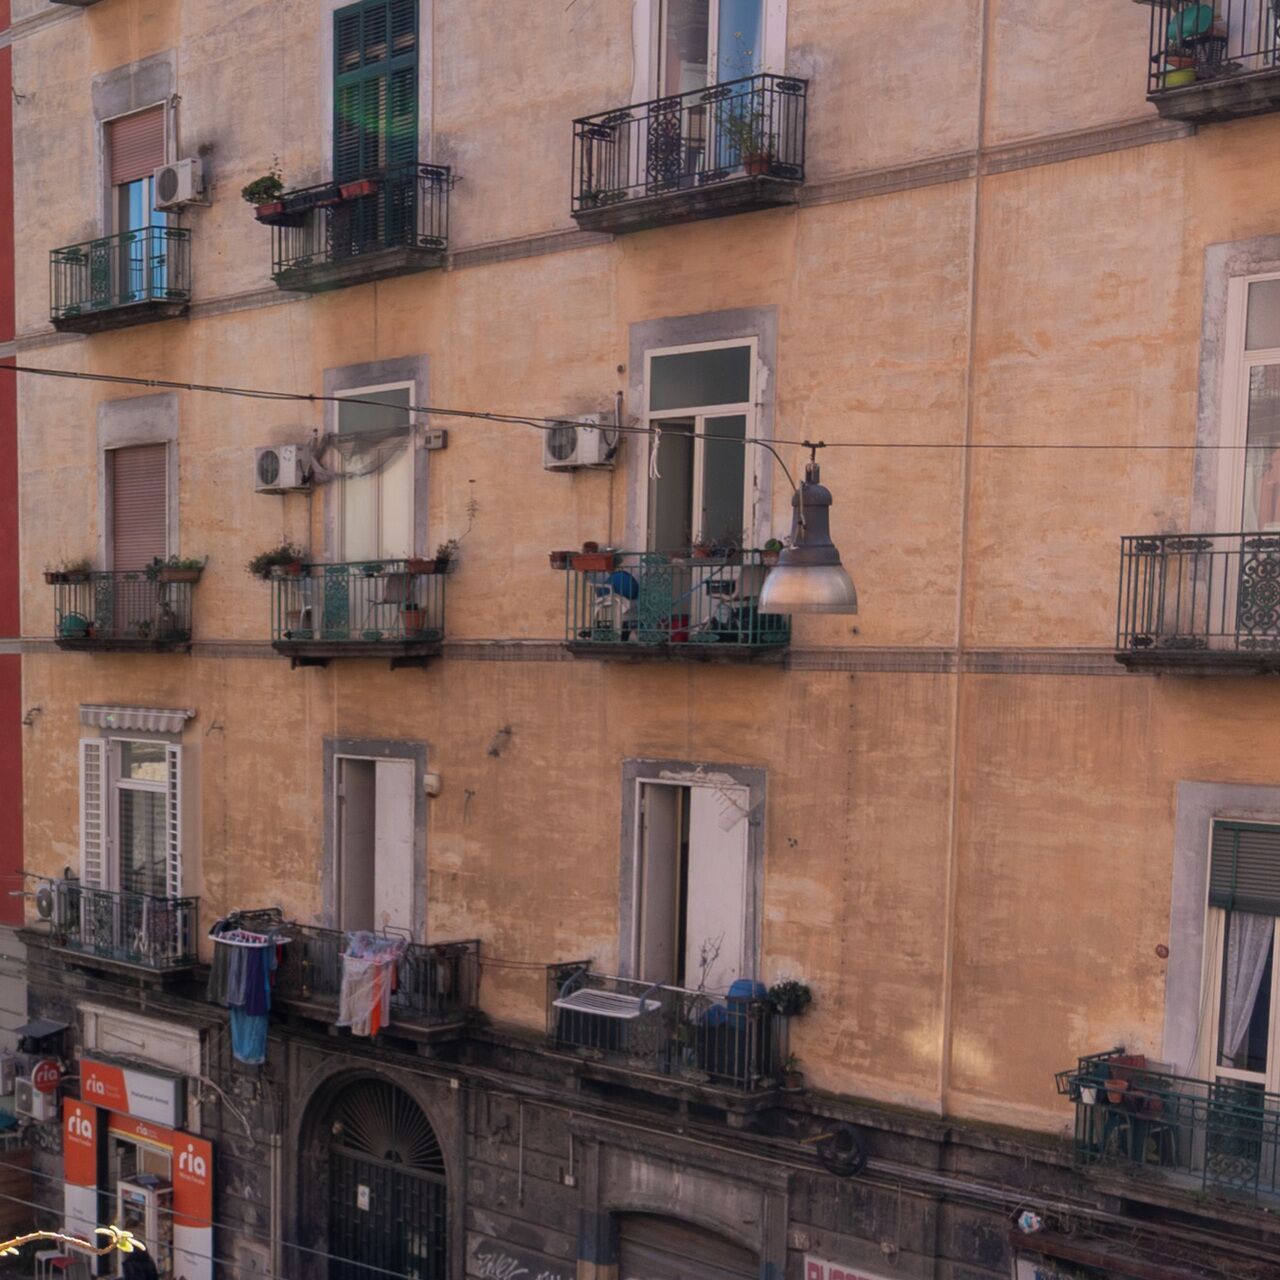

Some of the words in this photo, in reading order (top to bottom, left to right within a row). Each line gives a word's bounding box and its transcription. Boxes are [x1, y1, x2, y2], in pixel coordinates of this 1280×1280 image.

[37, 1065, 58, 1083] ria
[86, 1073, 105, 1096] ria
[68, 1107, 92, 1139] ria
[135, 1122, 148, 1136] ria
[178, 1143, 206, 1177] ria
